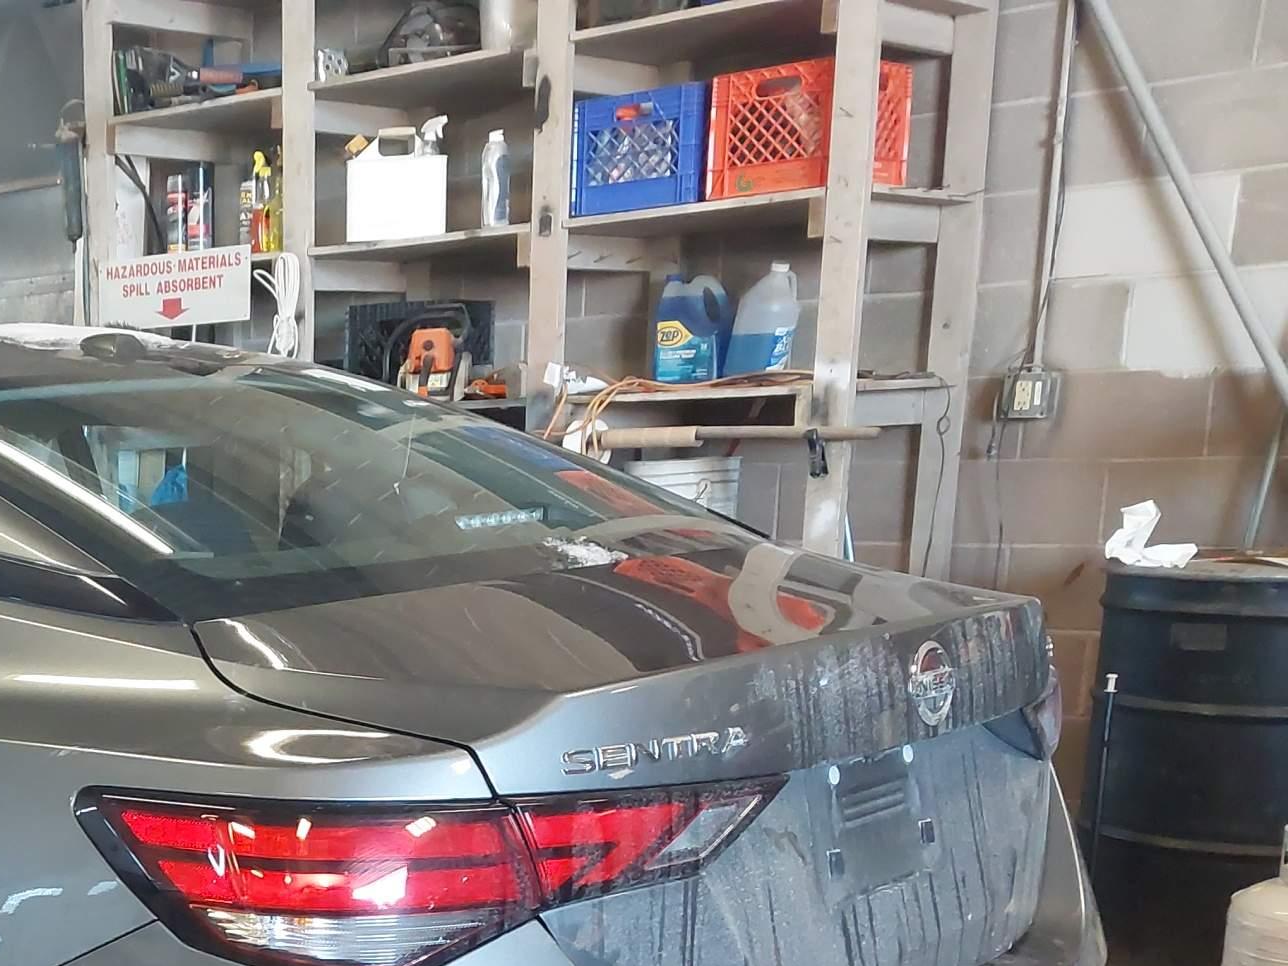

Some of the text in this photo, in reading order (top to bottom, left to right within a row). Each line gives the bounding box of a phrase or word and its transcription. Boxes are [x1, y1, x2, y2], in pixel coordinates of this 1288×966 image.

[106, 252, 241, 280] HAZARDOUS MATERIALS
[122, 275, 224, 299] SPILL ABSORBENT
[561, 726, 750, 776] SENTRA
